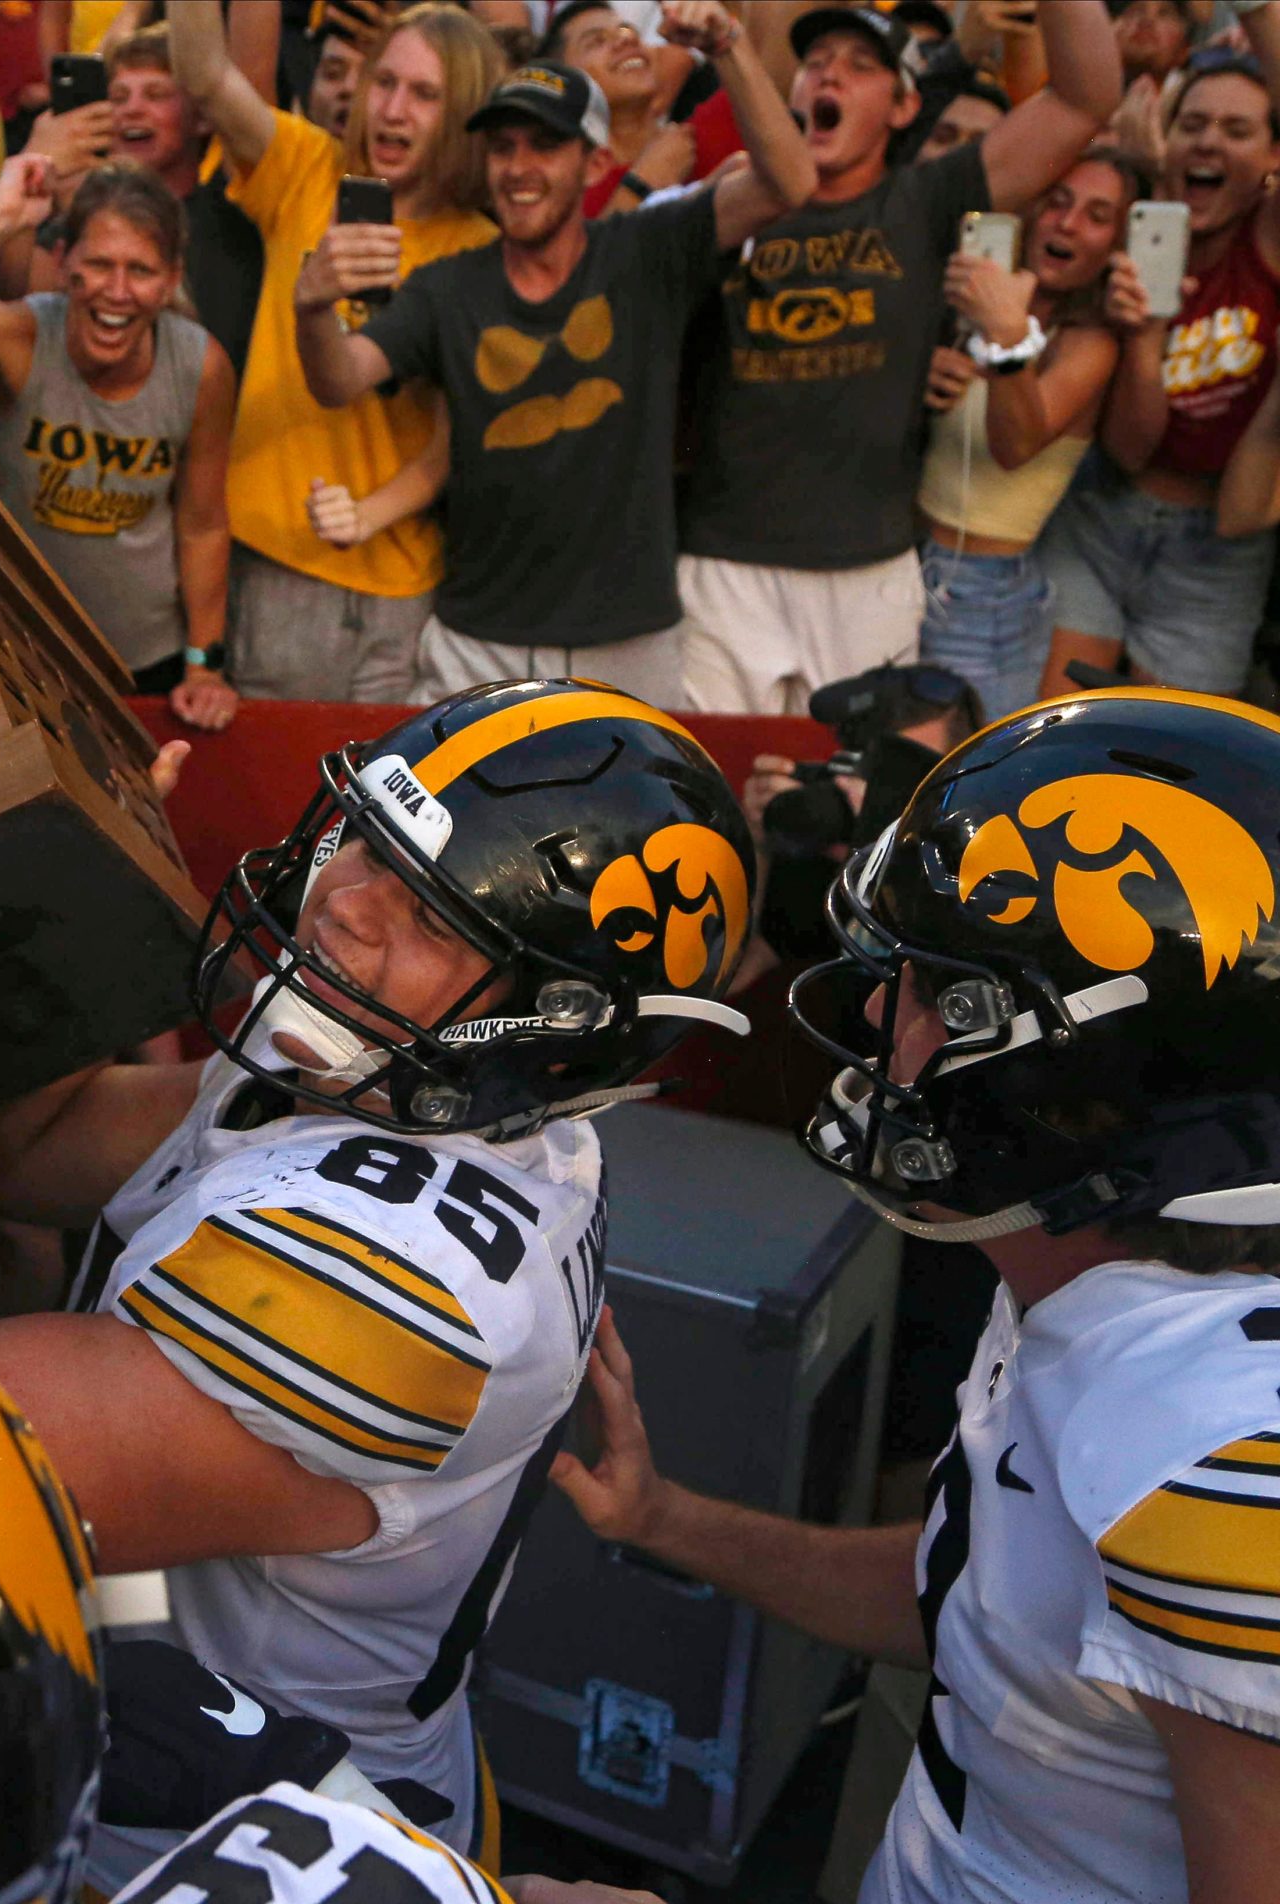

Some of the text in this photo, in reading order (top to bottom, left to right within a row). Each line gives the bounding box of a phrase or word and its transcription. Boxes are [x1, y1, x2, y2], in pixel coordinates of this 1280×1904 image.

[24, 416, 175, 478] IOWA
[382, 767, 427, 818] IOWA
[315, 1135, 540, 1284] 85
